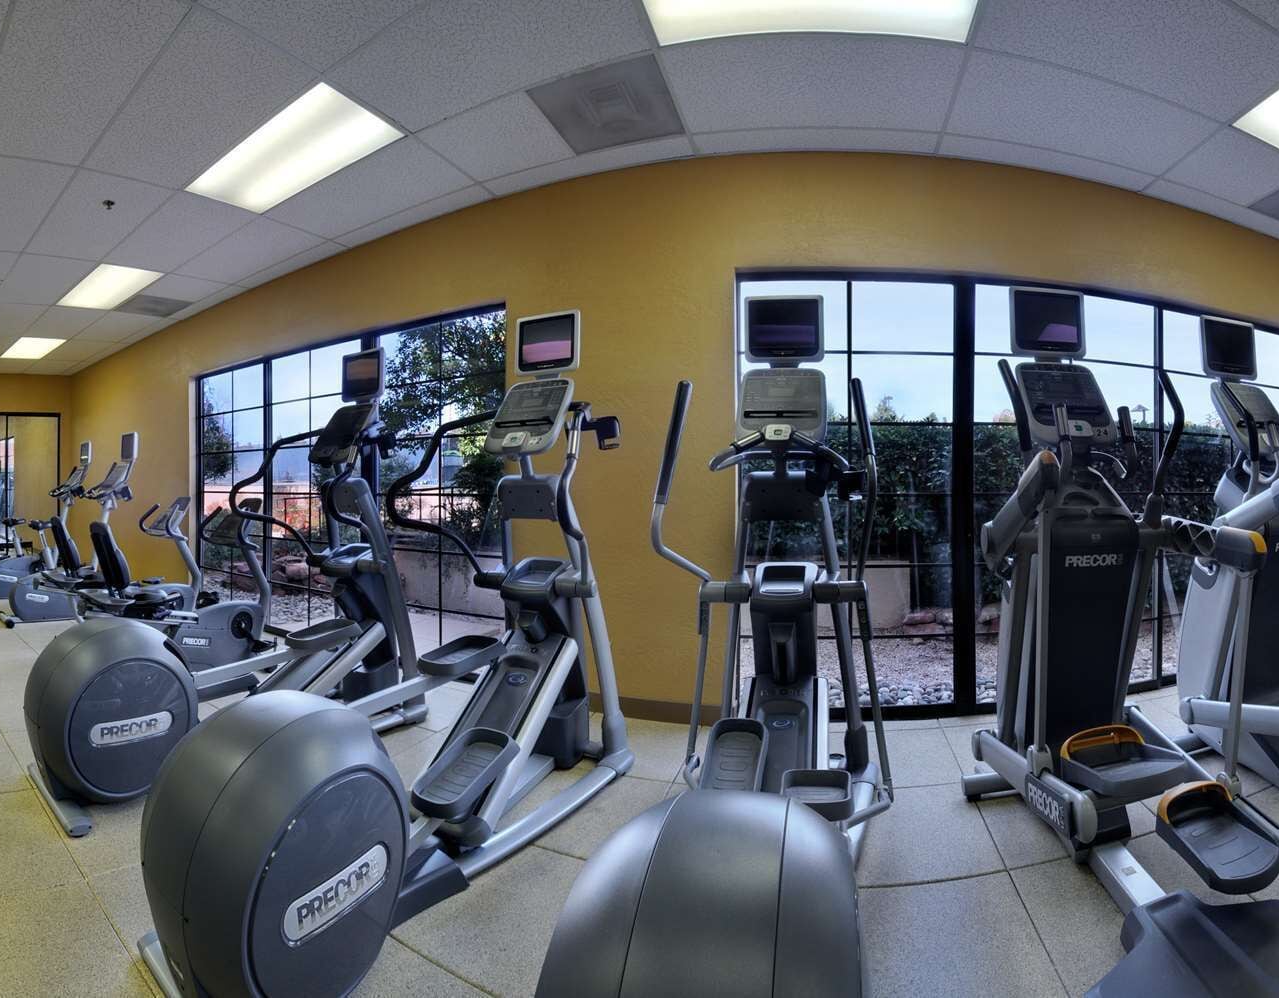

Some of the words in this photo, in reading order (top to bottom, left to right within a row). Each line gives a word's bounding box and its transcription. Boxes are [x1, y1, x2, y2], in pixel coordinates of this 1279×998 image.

[1065, 554, 1117, 567] PRECOR
[100, 718, 159, 738] PRECOR
[1028, 782, 1060, 825] PRECOR
[296, 861, 370, 931] PRECOR
